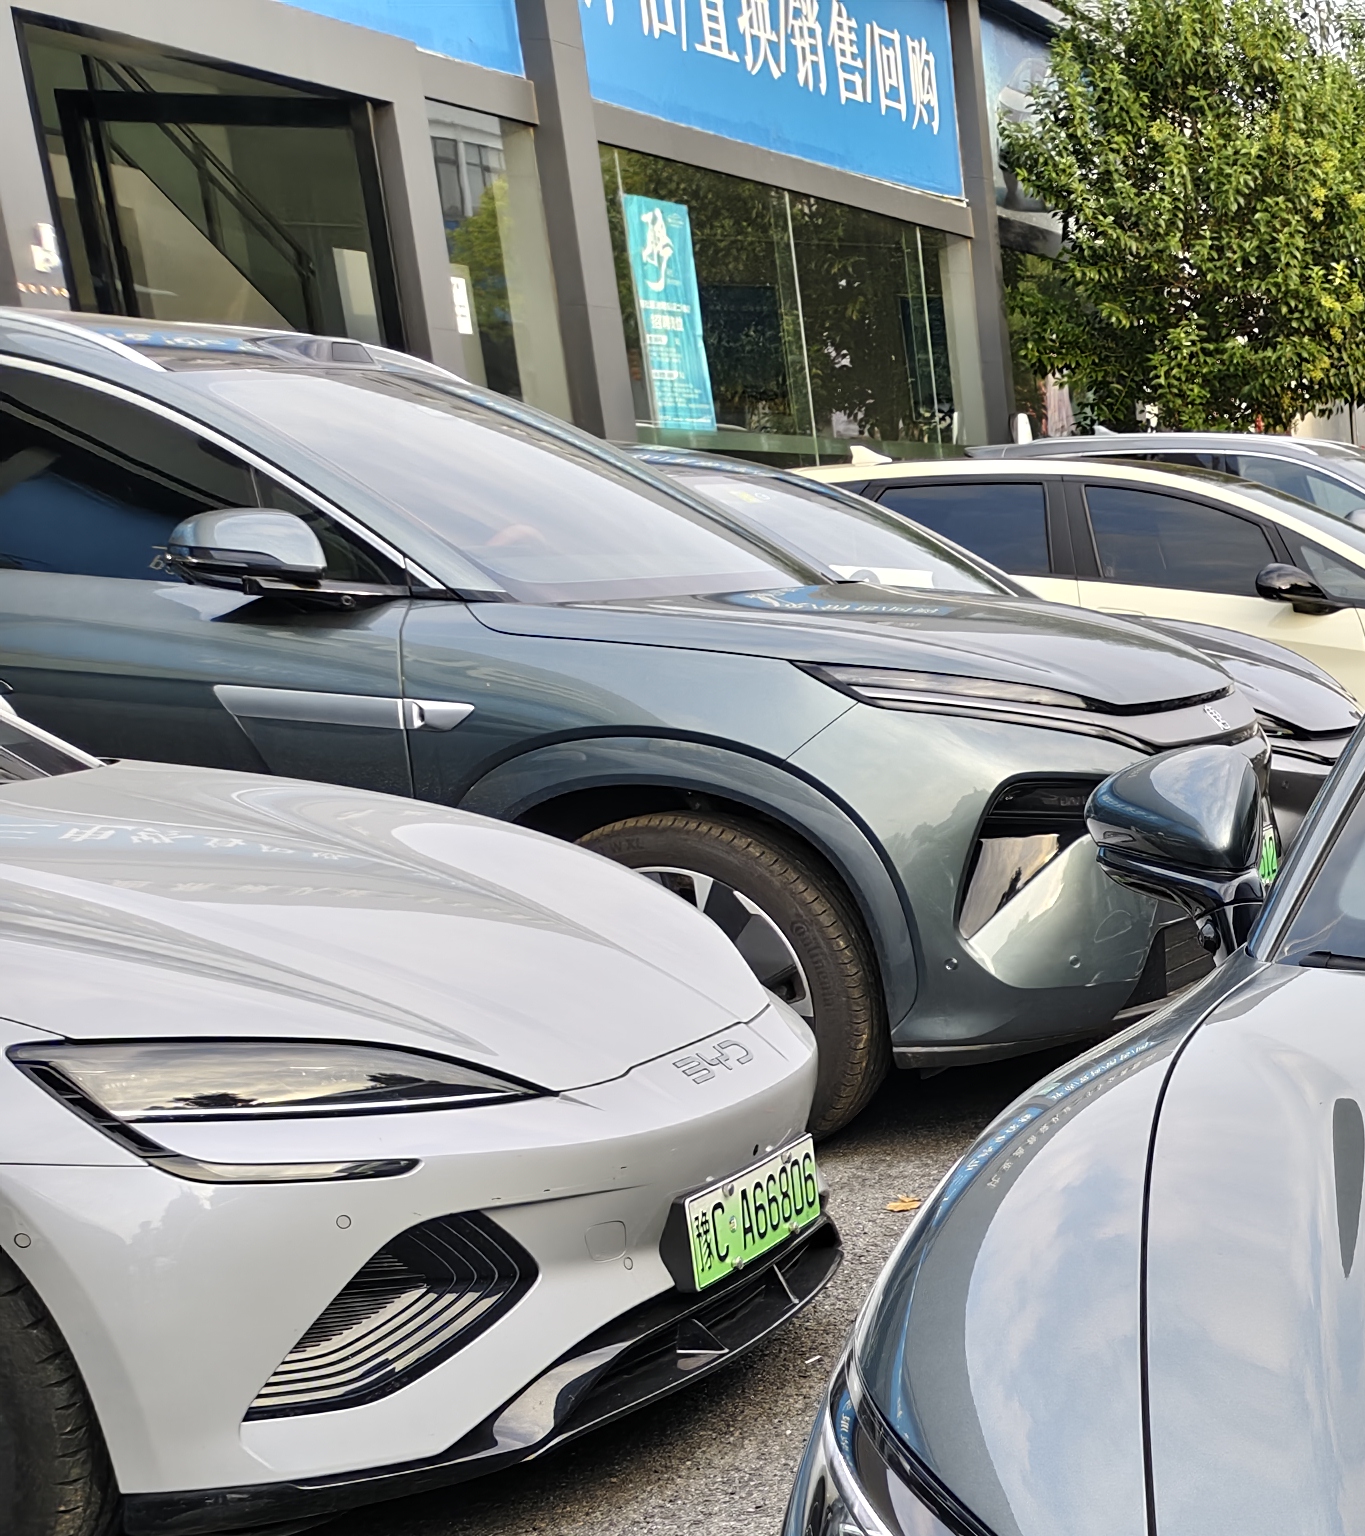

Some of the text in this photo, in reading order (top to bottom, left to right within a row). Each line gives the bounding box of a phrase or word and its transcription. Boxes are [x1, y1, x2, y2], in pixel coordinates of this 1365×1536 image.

[584, 0, 941, 135] /置换/销售/回购
[672, 1039, 753, 1085] BYD
